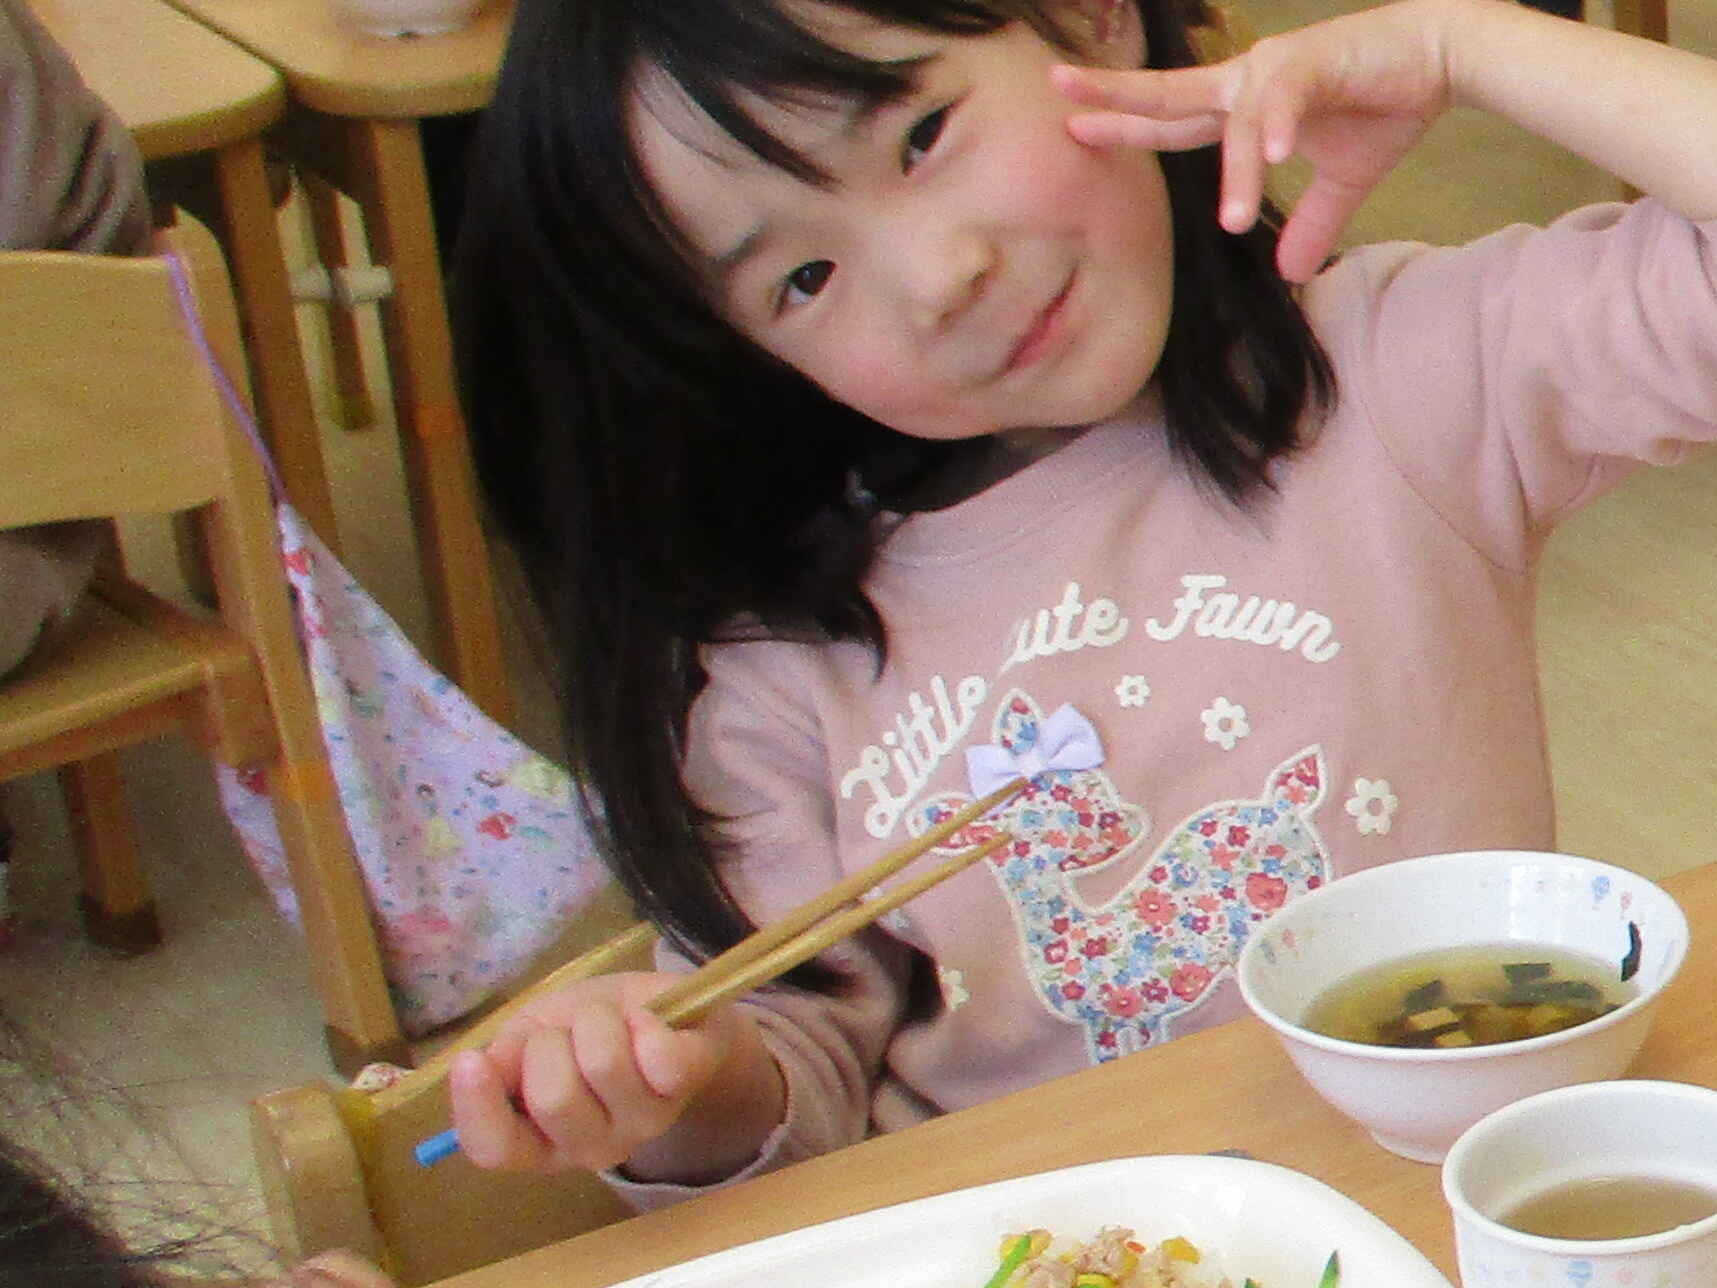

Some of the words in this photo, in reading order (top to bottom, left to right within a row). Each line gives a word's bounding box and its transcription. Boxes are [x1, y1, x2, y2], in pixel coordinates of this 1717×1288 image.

[840, 673, 988, 839] Little
[999, 581, 1129, 674] ute
[1145, 574, 1342, 663] Fawn
